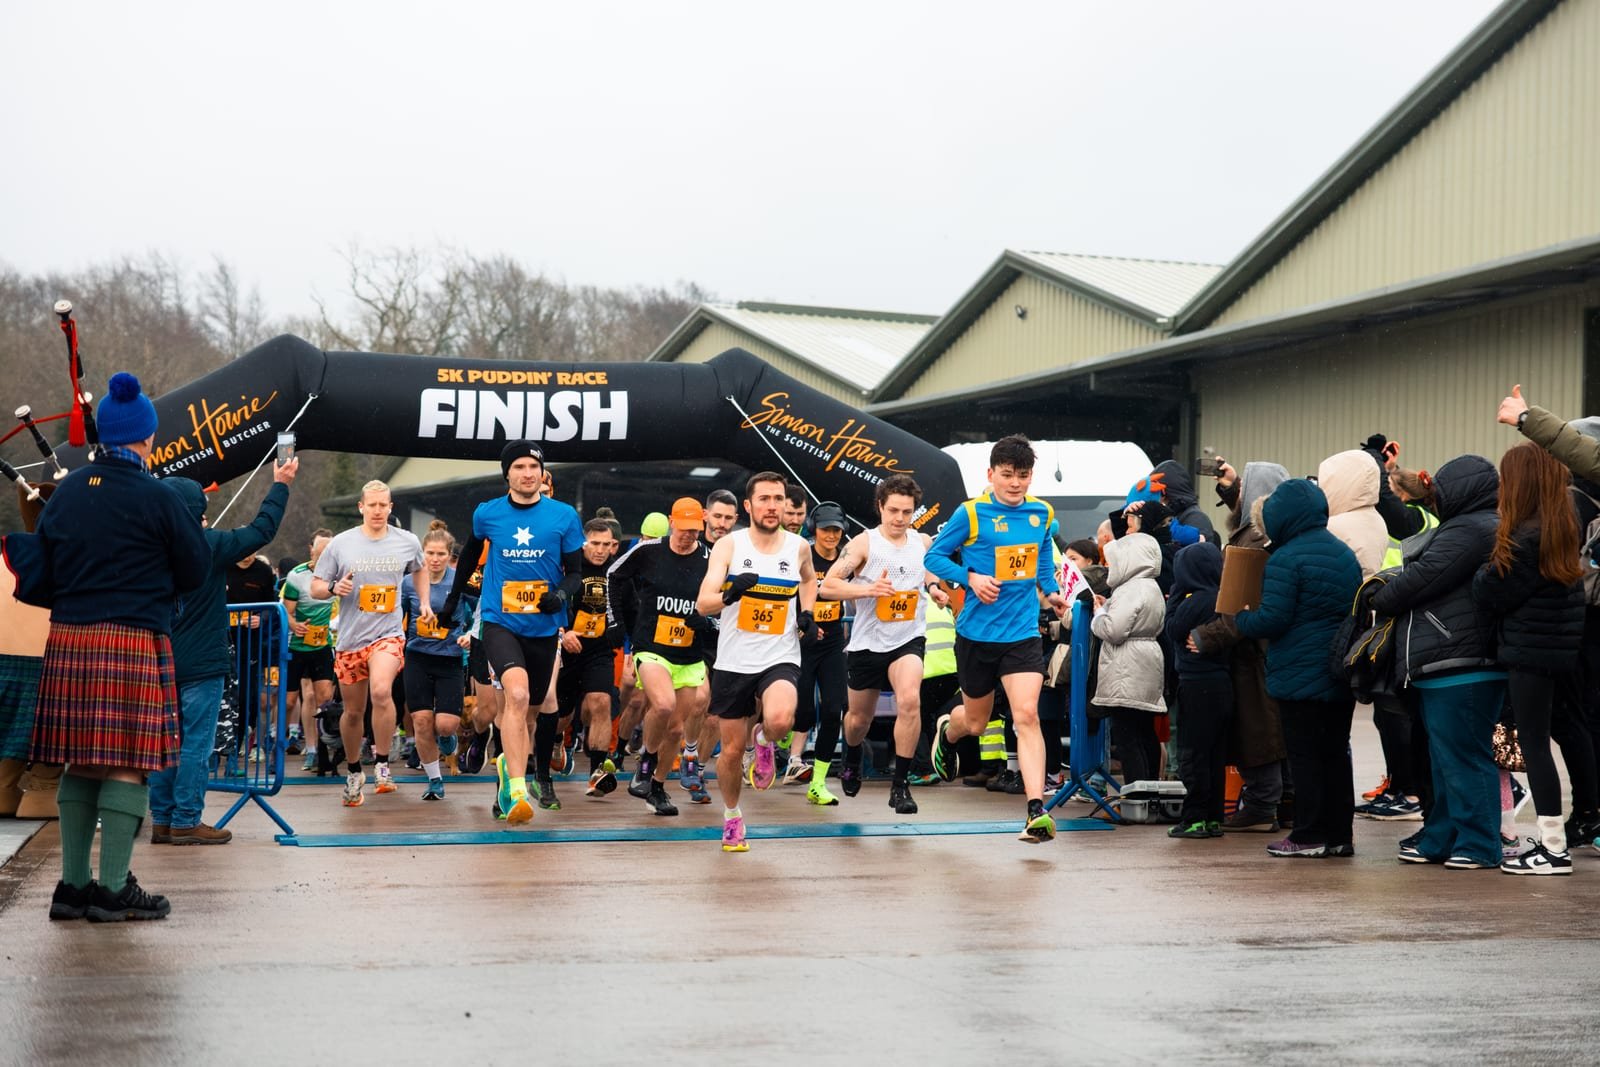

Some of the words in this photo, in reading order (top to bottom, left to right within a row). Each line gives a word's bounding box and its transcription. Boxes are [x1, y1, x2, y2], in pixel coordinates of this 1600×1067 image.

[437, 368, 465, 383] 5K
[467, 369, 552, 385] PUDDIN'
[557, 371, 608, 385] RACE
[418, 388, 628, 442] FINISH
[188, 390, 277, 460] Howie
[741, 392, 825, 444] Simon
[825, 419, 914, 472] Howie
[163, 447, 215, 475] SCOTTISH
[222, 421, 271, 448] BUTCHER
[766, 424, 781, 437] THE
[784, 433, 832, 462] SCOTTISH
[502, 549, 545, 558] SAYSKY
[1009, 555, 1027, 569] 267
[370, 593, 386, 604] 371
[516, 591, 535, 602] 400
[890, 600, 907, 611] 466
[752, 609, 773, 623] 365
[817, 610, 832, 620] 465
[586, 621, 596, 630] 52
[669, 625, 685, 637] 190
